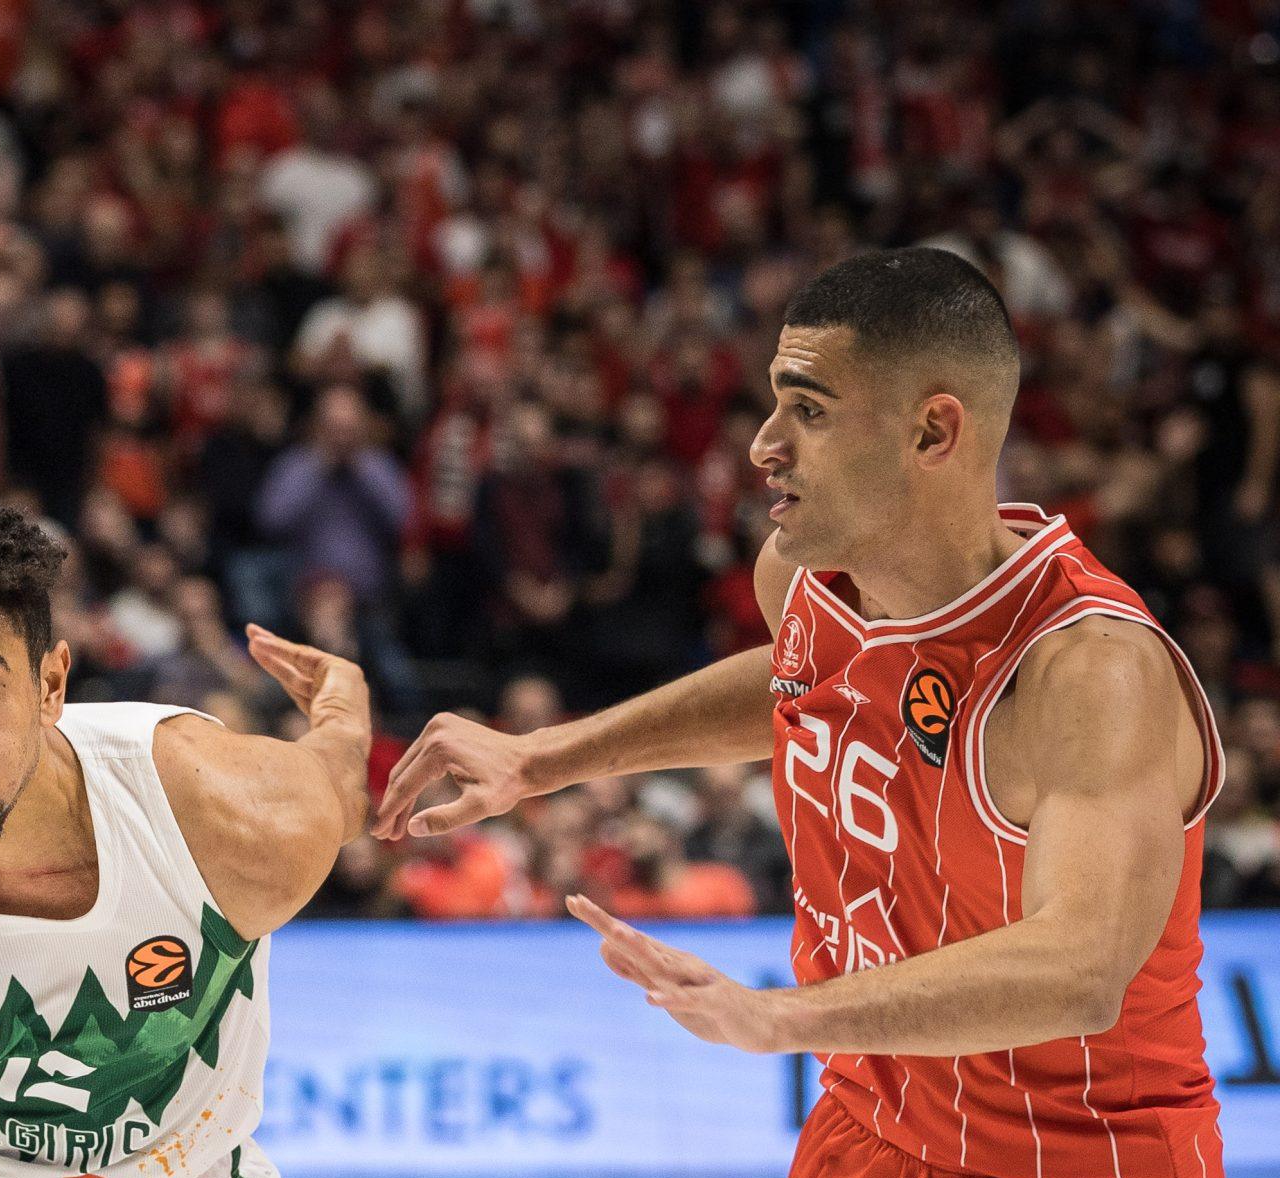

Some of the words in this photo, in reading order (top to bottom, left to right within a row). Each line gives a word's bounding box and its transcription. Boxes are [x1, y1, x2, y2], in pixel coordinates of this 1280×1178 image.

[785, 713, 899, 854] 26
[133, 999, 156, 1009] abu
[157, 989, 190, 1004] dhabi
